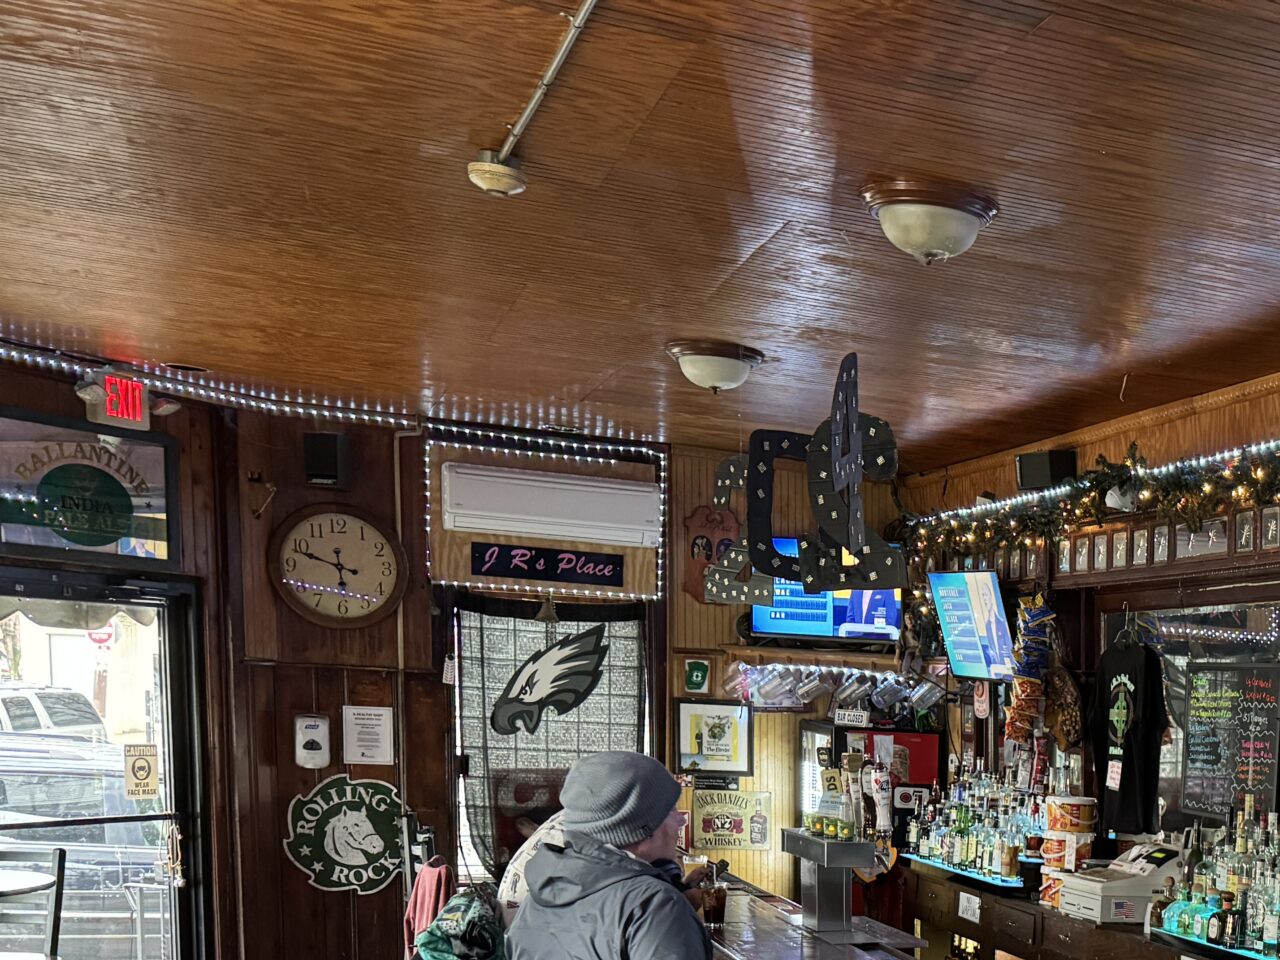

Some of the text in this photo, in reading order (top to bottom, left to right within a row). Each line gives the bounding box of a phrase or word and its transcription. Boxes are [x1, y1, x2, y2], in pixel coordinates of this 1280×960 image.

[105, 375, 143, 421] EXIT
[14, 442, 150, 497] BALLANTINE
[60, 495, 114, 514] INDIA
[43, 509, 89, 529] PALE
[329, 518, 347, 534] 12
[309, 522, 323, 538] 11
[360, 526, 365, 541] 1
[292, 538, 309, 553] 10
[374, 542, 385, 557] 2
[285, 556, 297, 573] 9
[381, 561, 392, 577] 3
[481, 546, 614, 577] J R's Place
[374, 582, 385, 596] 4
[313, 592, 322, 608] 7
[337, 599, 349, 615] 6
[847, 713, 864, 724] CLOSED
[126, 746, 157, 756] CAUTION
[127, 787, 157, 796] FACE MASK
[697, 793, 717, 809] JACK
[297, 785, 390, 836] ROLLING
[703, 837, 742, 847] WHISKEY
[330, 850, 401, 885] ROCK
